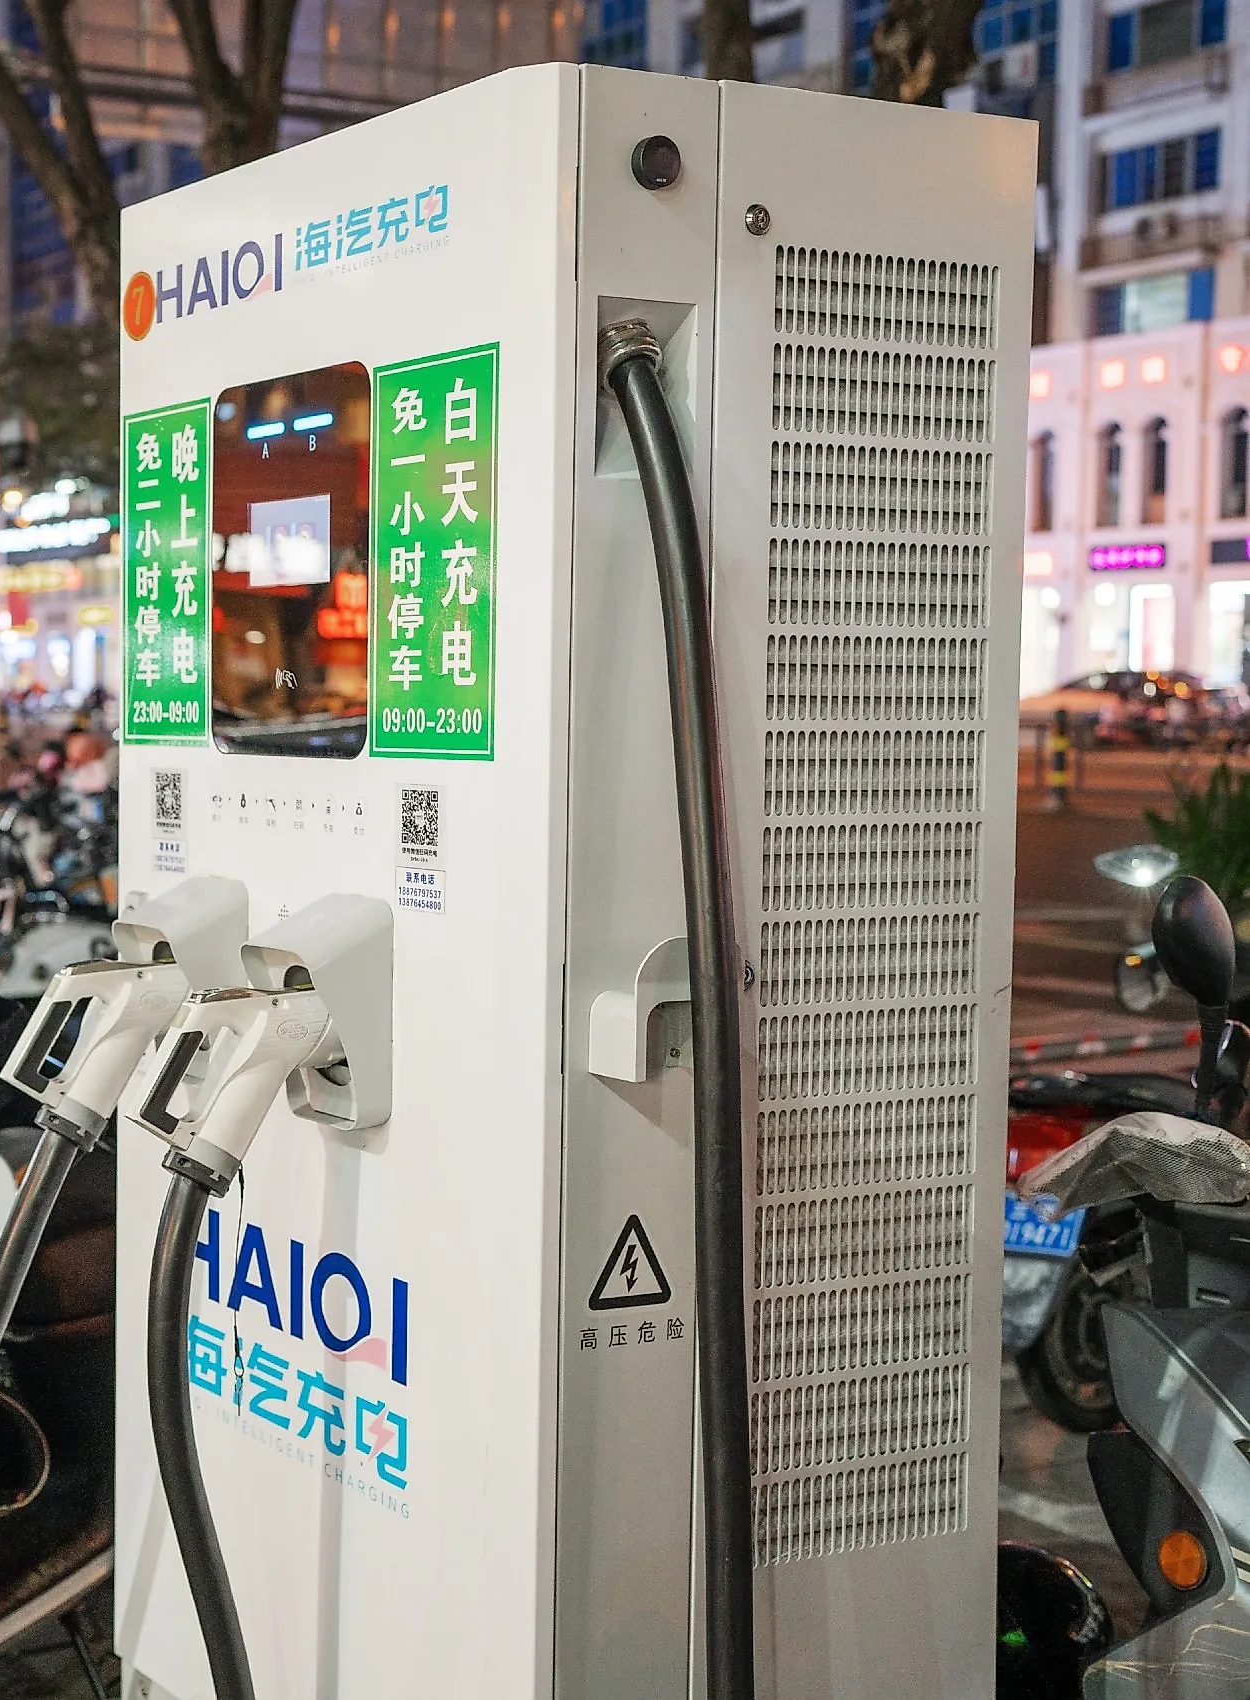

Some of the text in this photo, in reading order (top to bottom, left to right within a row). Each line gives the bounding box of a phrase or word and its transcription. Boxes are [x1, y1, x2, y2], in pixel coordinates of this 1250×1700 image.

[294, 184, 448, 271] 海汽充电
[395, 235, 449, 259] CHARGING
[261, 442, 270, 460] A
[308, 434, 317, 452] B
[387, 387, 427, 690] 免一小时停车
[440, 377, 479, 686] 白天充电
[135, 431, 162, 688] 免二小时停车
[171, 423, 199, 685] 晚上充电
[133, 700, 200, 724] 23:00-09:00
[382, 707, 483, 735] 09:00-23:00
[406, 871, 435, 885] 联系电话
[579, 1317, 686, 1351] 高压危险
[216, 1408, 410, 1519] INTELLIGENT CHARGING
